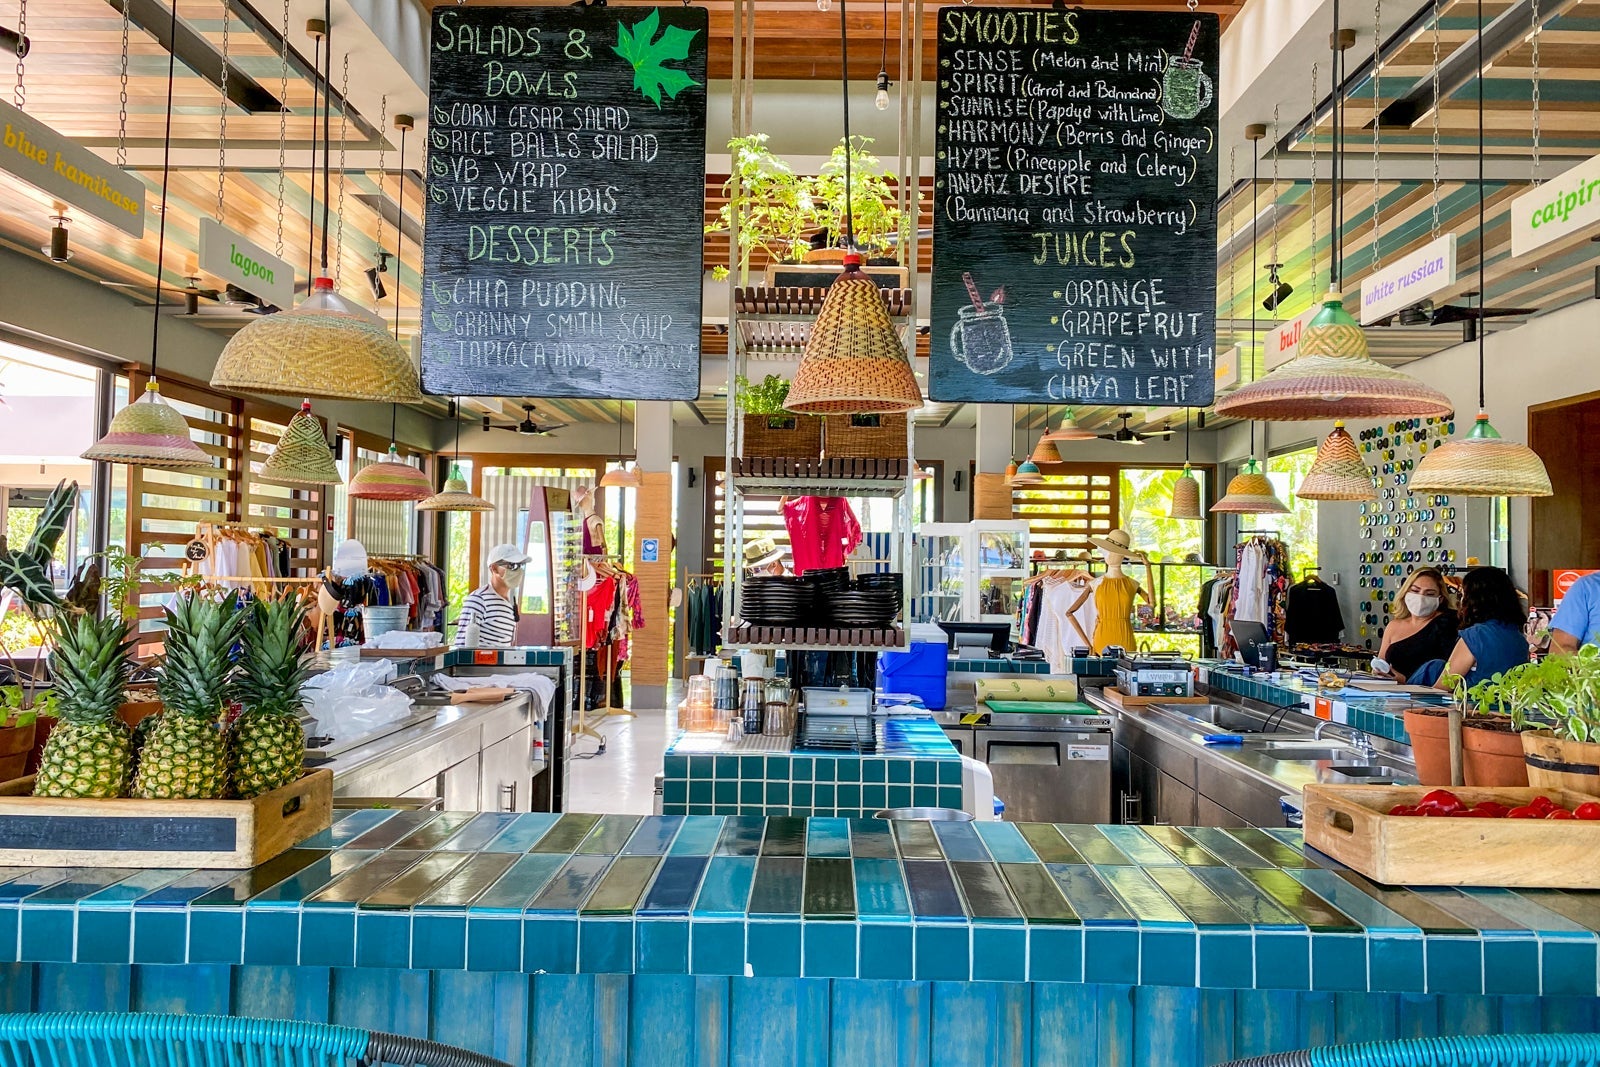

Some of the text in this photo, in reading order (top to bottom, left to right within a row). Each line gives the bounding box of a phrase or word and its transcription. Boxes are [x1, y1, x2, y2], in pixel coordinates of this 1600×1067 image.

[435, 12, 593, 60] SALADS &
[942, 10, 1080, 45] SMOOTIES
[953, 48, 1169, 74] SENSE (Melon and Mint)
[483, 60, 578, 99] BOWLS
[950, 72, 1021, 96] SPIRIT
[1021, 74, 1065, 98] (Carrot
[1067, 81, 1091, 98] and
[451, 103, 630, 132] CORN CESAR SALAD
[947, 95, 1165, 126] SUNRISE (Papaya with Lime)
[451, 130, 659, 163] RICE BALLS SALAD
[948, 119, 1214, 156] HARMONY (Berris and Ginger)
[3, 124, 140, 216] blue kamikase
[451, 156, 567, 189] VB WRAP
[947, 145, 1197, 187] HYPE (Pineapple and Celery)
[451, 185, 619, 214] VEGGIE KIBIS
[948, 171, 1093, 196] ANDAZ DESIRE
[1042, 198, 1075, 223] and
[1084, 199, 1197, 236] Strawberry)
[1531, 178, 1600, 229] caipir
[468, 225, 617, 267] DESSERTS
[1031, 230, 1137, 269] JUICES
[230, 244, 275, 285] lagoon
[1364, 255, 1444, 307] white russian
[452, 277, 626, 309] CHIA PUDDING
[1064, 278, 1167, 312] ORANGE
[454, 310, 673, 342] GRANNY SMITH SOUP
[1062, 309, 1204, 340] GRAPEFRUT
[456, 340, 546, 367] TAPIOCA
[553, 342, 595, 367] AND
[1057, 340, 1136, 370] GREEN
[1151, 344, 1214, 370] WITH
[1048, 374, 1194, 403] CHAYA LEAF
